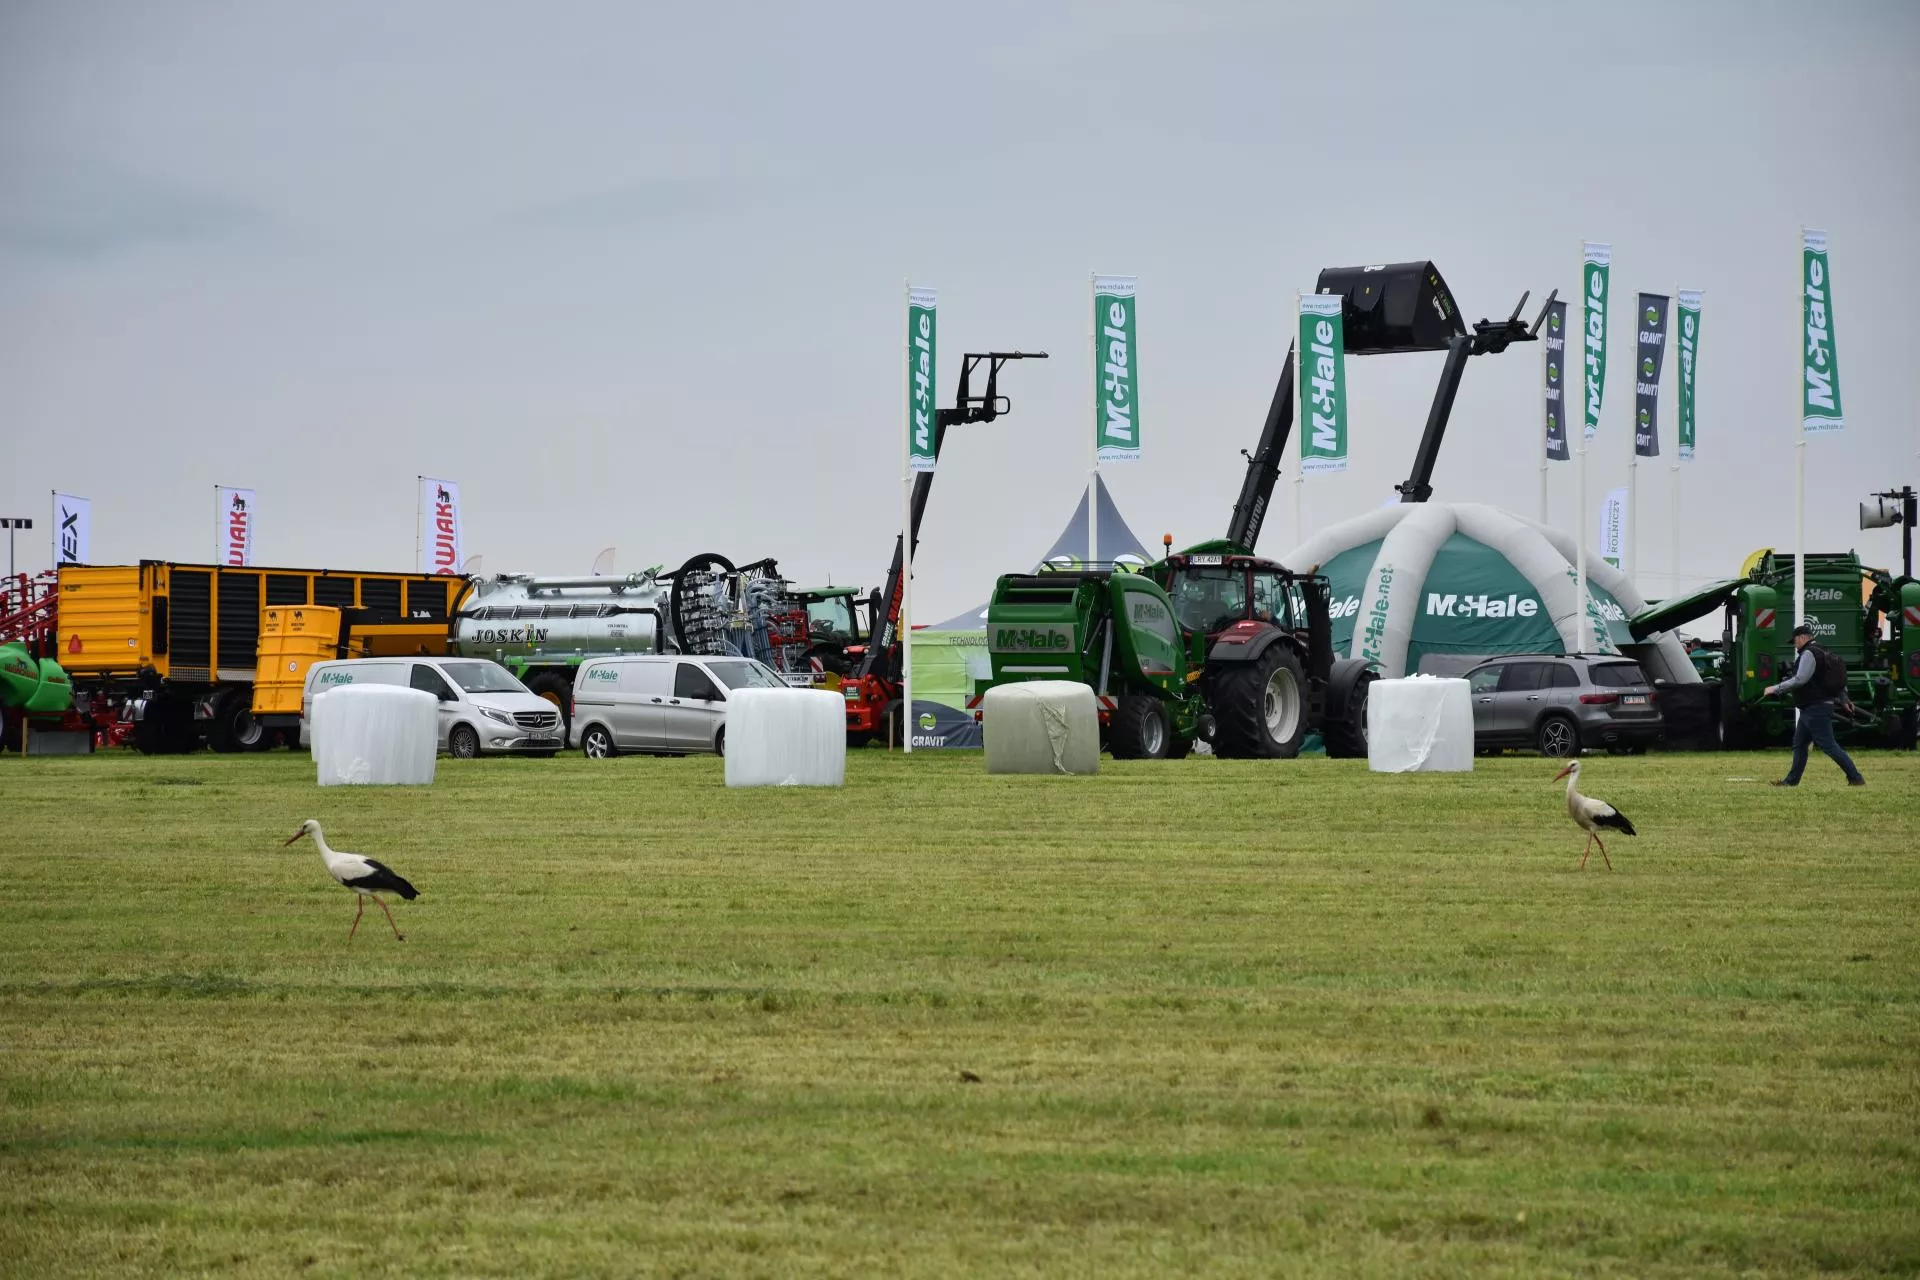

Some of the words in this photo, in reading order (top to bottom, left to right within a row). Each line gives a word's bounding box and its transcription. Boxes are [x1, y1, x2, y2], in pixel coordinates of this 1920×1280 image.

[1586, 270, 1603, 420] McHale
[1806, 259, 1835, 410] McHale
[915, 314, 930, 451] McHale
[1102, 302, 1132, 441] McHale
[1310, 320, 1337, 452] McHale
[61, 503, 78, 563] EX
[1611, 500, 1620, 553] ROLNICZY
[1134, 604, 1165, 620] McHale
[1426, 592, 1539, 618] McHale
[471, 628, 549, 644] JOSKIN
[996, 629, 1070, 650] McHale
[320, 672, 354, 685] McHale
[588, 668, 619, 681] McHale
[912, 735, 946, 747] GRAVIT
